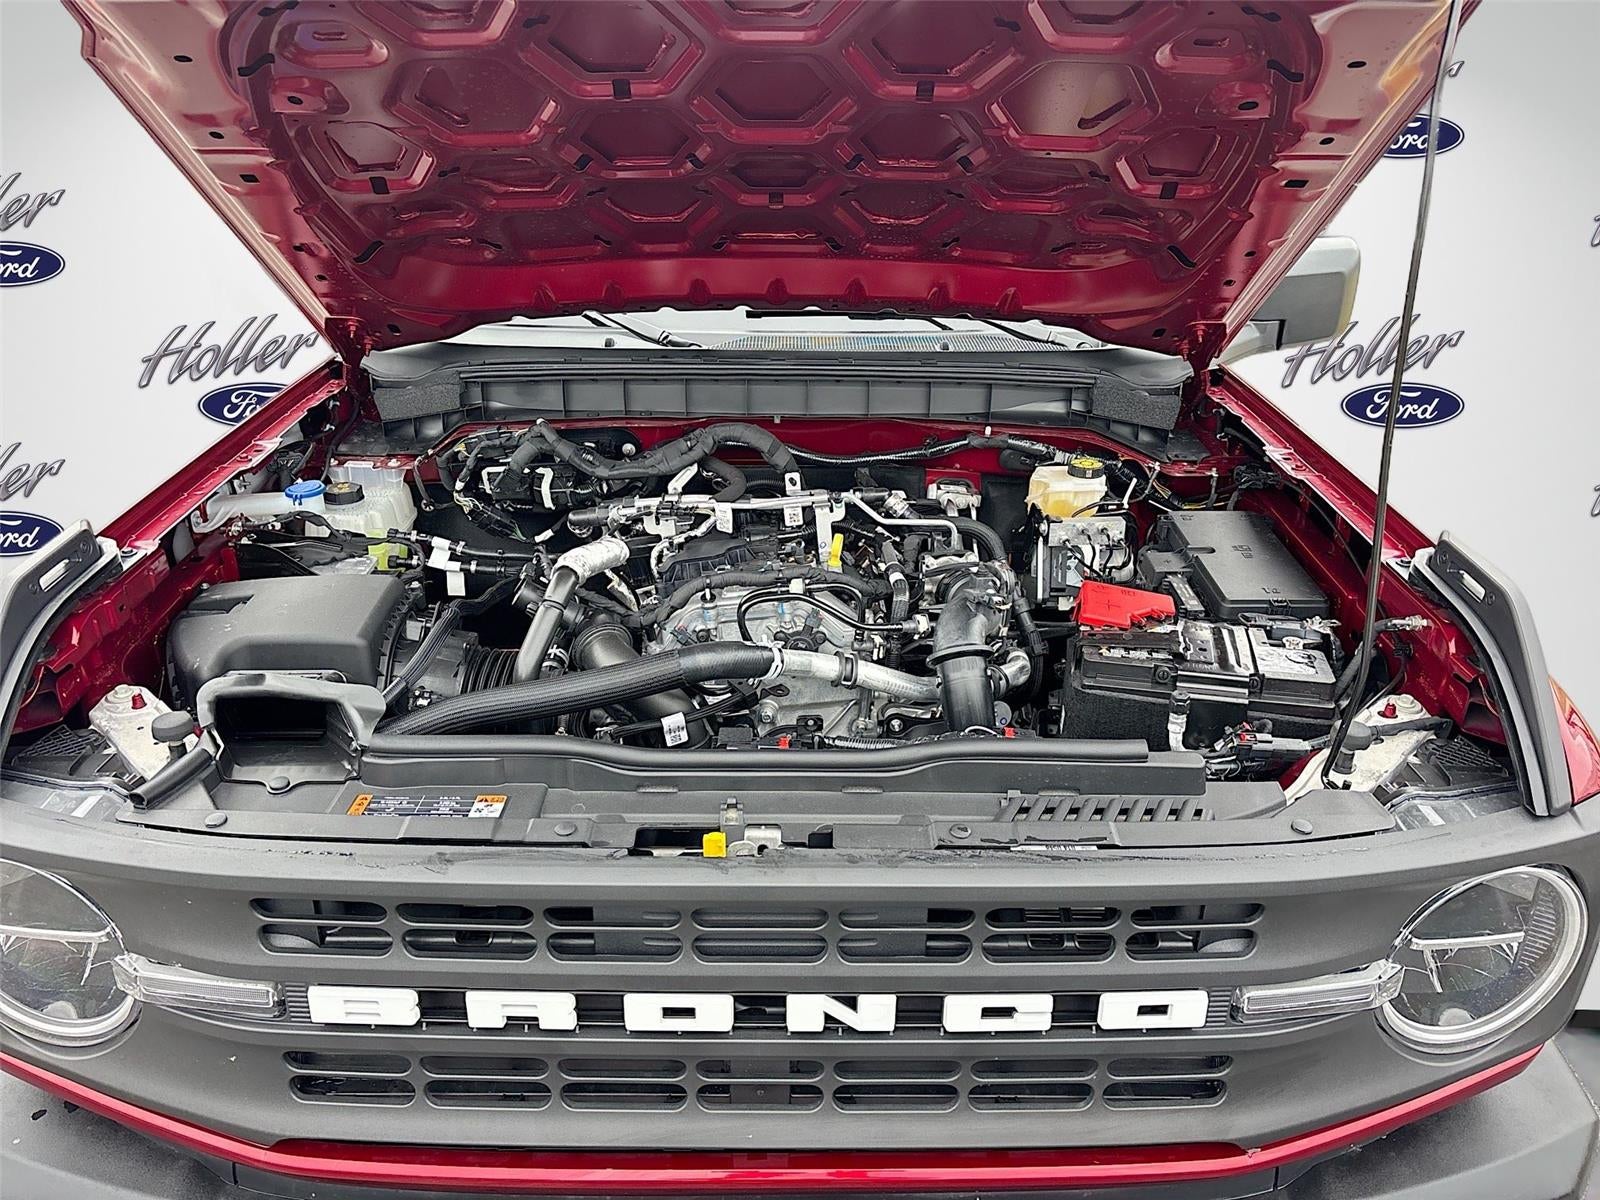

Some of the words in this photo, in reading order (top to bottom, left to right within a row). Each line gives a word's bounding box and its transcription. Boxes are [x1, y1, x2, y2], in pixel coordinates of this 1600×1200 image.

[138, 313, 319, 389] Holler
[1281, 313, 1465, 389] Holler
[306, 984, 1209, 1033] BRONCO
